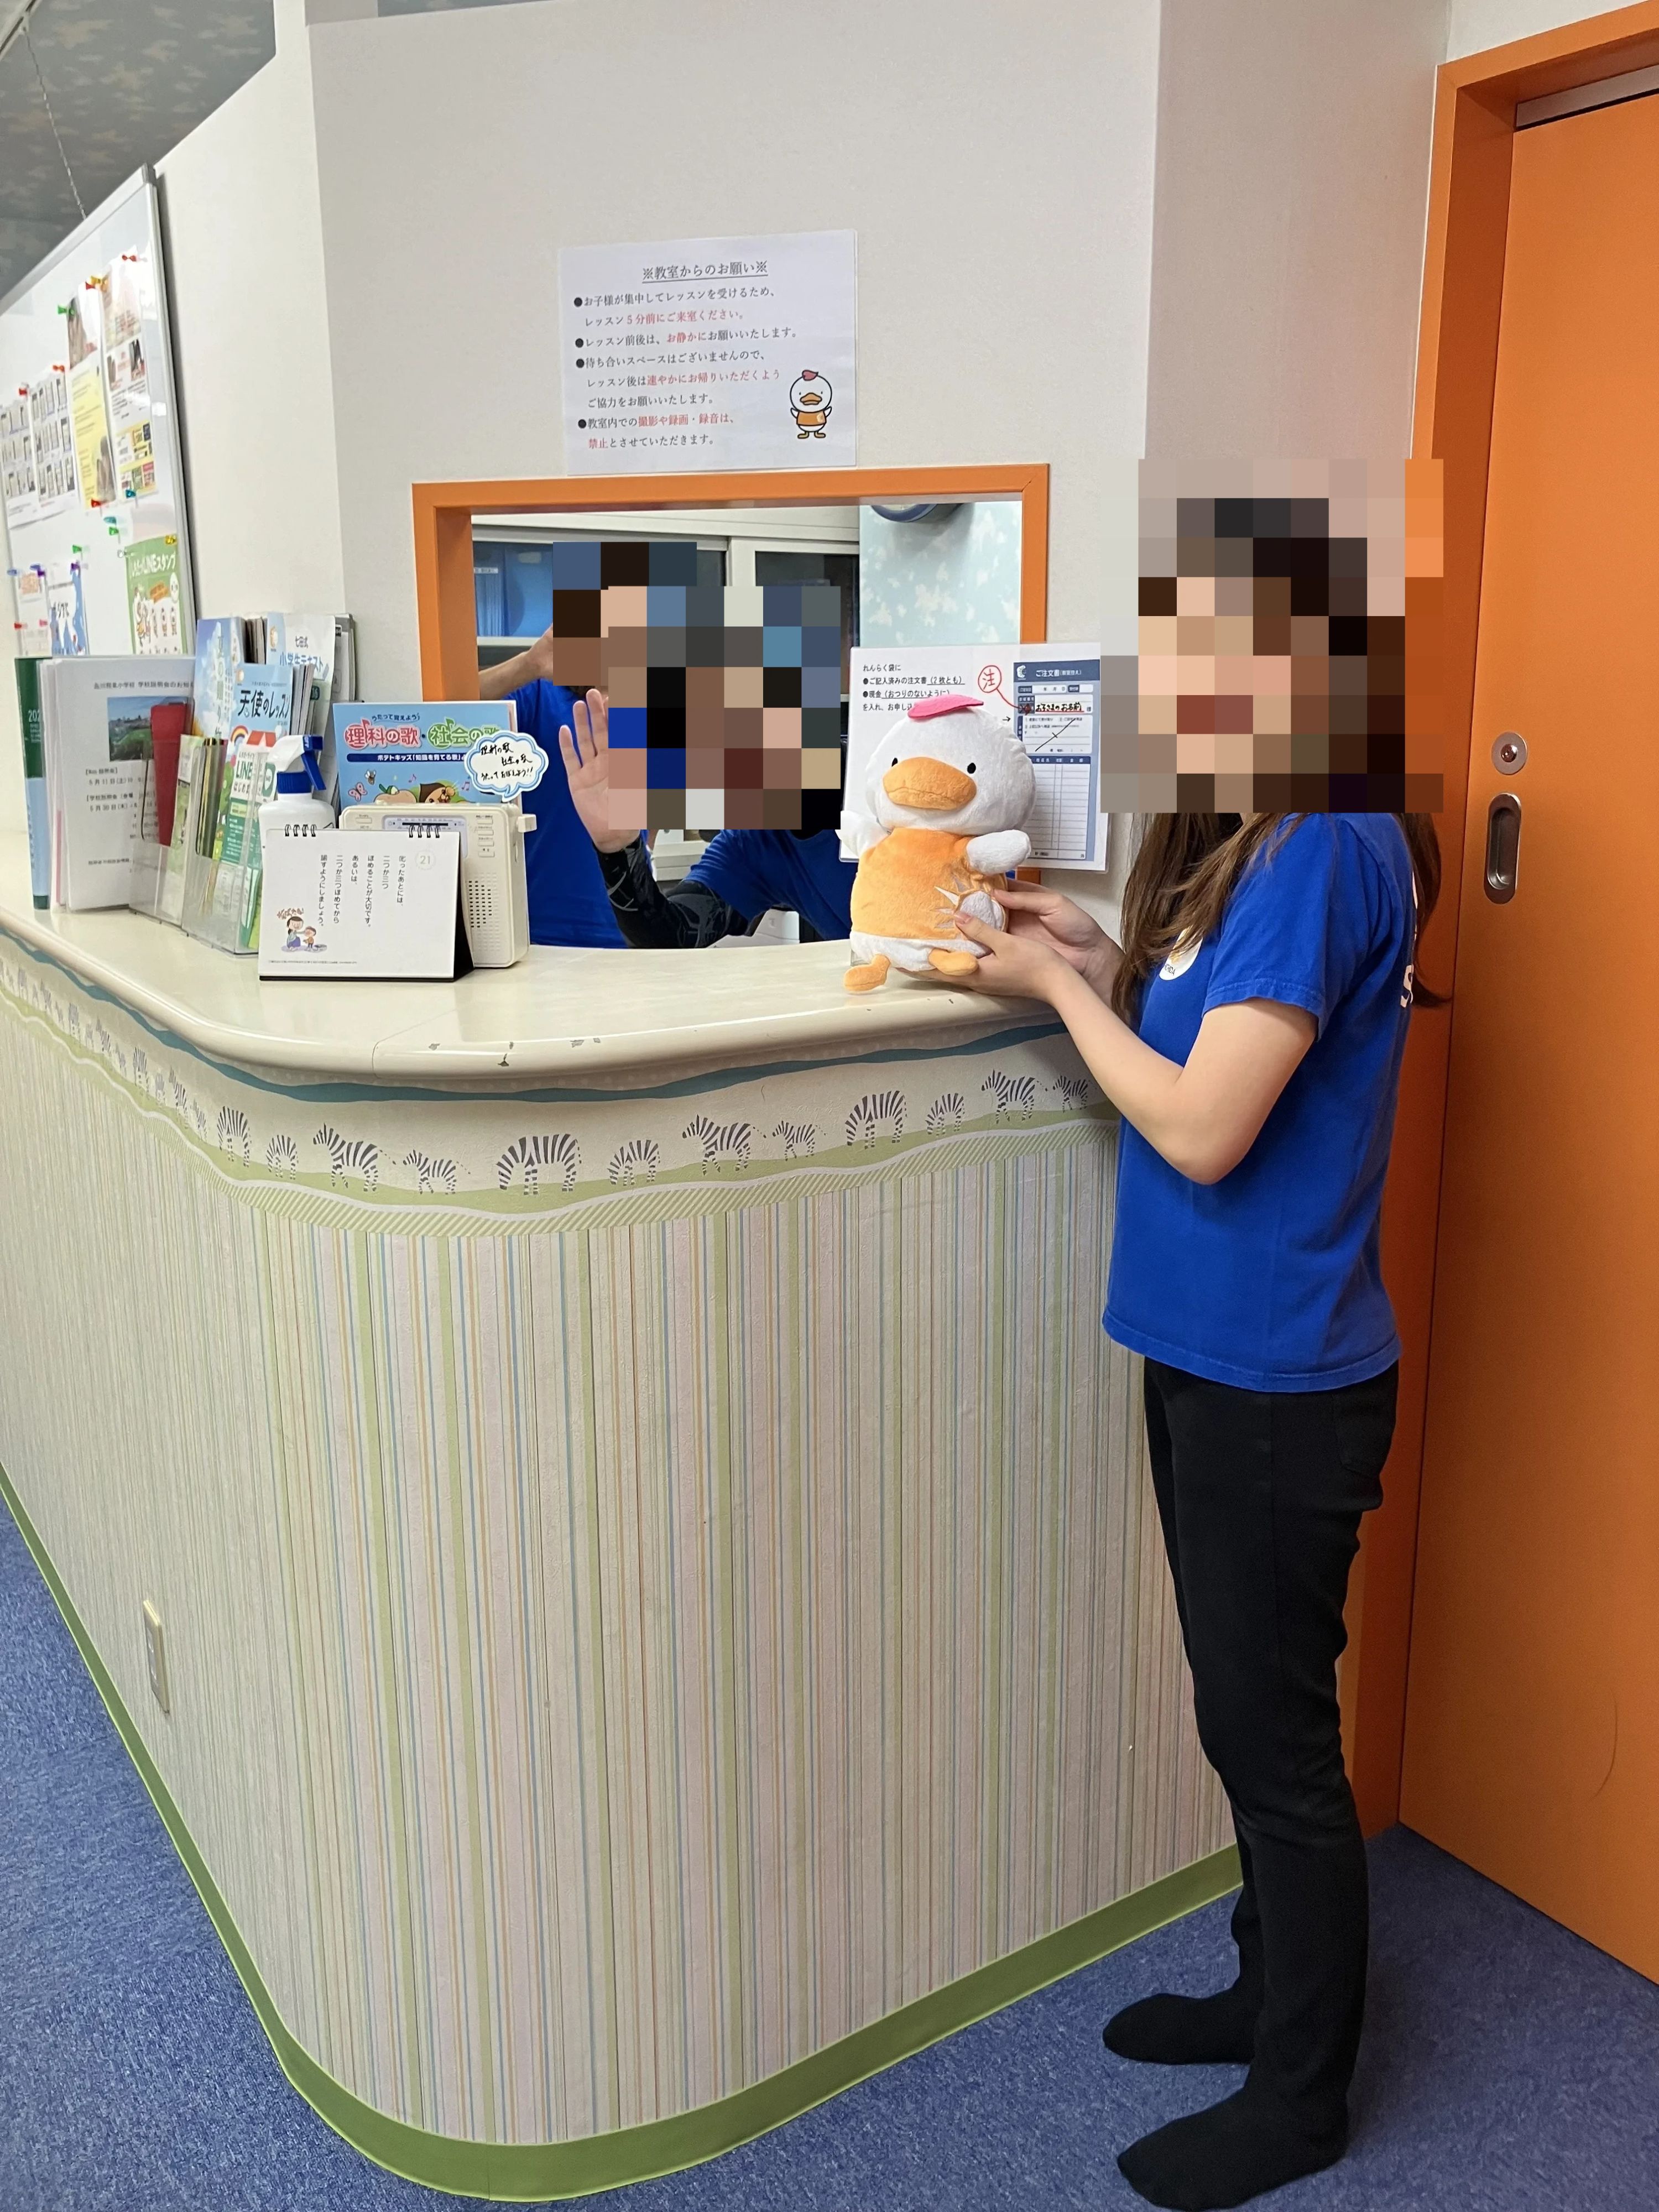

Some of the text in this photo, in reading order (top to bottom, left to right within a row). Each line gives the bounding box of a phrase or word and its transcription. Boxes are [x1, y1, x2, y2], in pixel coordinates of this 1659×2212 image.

[643, 260, 768, 280] ※教室からのお願い※
[584, 286, 774, 306] お子様が集中してレッスンを受けるため、
[585, 309, 743, 326] レッスン5分前にご来室ください。
[586, 327, 796, 347] レッスン前後は、お静かにお願いいたします。
[586, 350, 764, 369] 待ち合いスペースはございませんので、
[587, 369, 779, 388] レッスン後は速やかにお帰りいただくよう
[588, 393, 713, 409] ご協力をお願いいたします。
[587, 413, 734, 430] 教室内での撮影や録画・録音は、
[588, 434, 713, 449] 禁止とさせていただきます。
[295, 635, 309, 649] 七田式
[863, 664, 901, 672] れんらく袋に
[983, 669, 995, 690] 注
[238, 690, 290, 719] 天使のレッスン
[372, 713, 420, 722] うたって覚えよう
[420, 855, 431, 864] 21
[351, 855, 359, 885] あるいは、
[382, 855, 390, 889] 二つか三つ
[318, 854, 327, 926] 諭すようにしましょう。
[333, 855, 343, 924] 二つか三つほめてから
[397, 855, 406, 906] 叱ったあとには、
[364, 855, 374, 927] ほめることが大切です。
